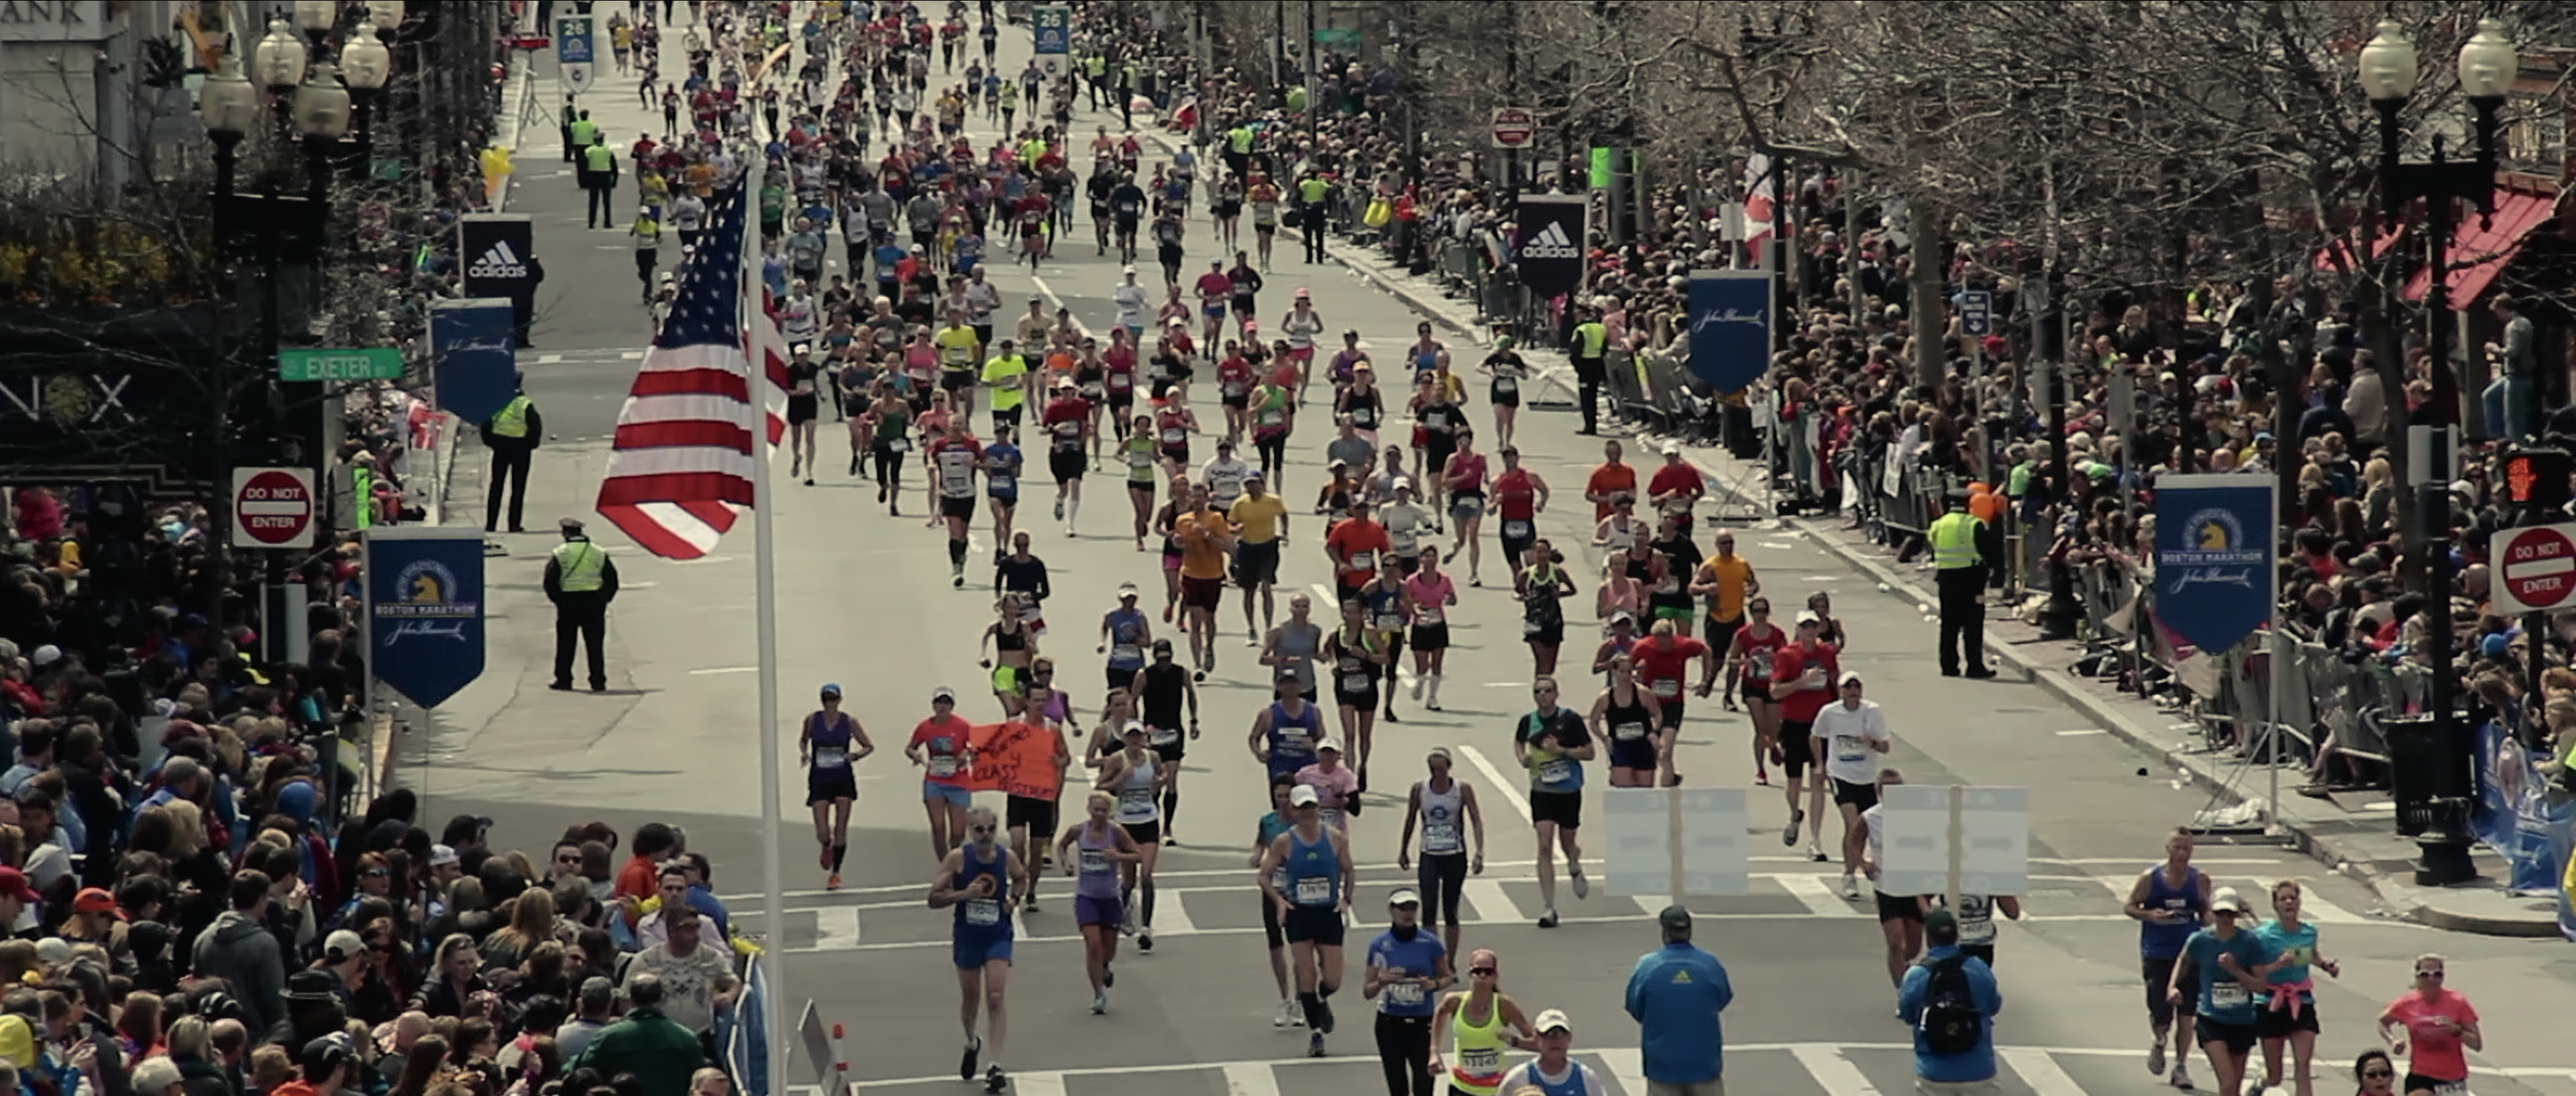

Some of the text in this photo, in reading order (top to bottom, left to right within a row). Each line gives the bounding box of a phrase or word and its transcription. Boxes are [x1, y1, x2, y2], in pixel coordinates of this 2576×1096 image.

[1040, 14, 1061, 27] 26
[564, 23, 585, 36] 26
[1521, 244, 1578, 258] adidas
[469, 264, 527, 278] adidas
[306, 356, 370, 379] EXETER
[246, 488, 301, 499] DO NOT
[252, 516, 295, 528] ENTER
[2515, 541, 2561, 559] DO NOT
[2523, 578, 2563, 594] ENTER
